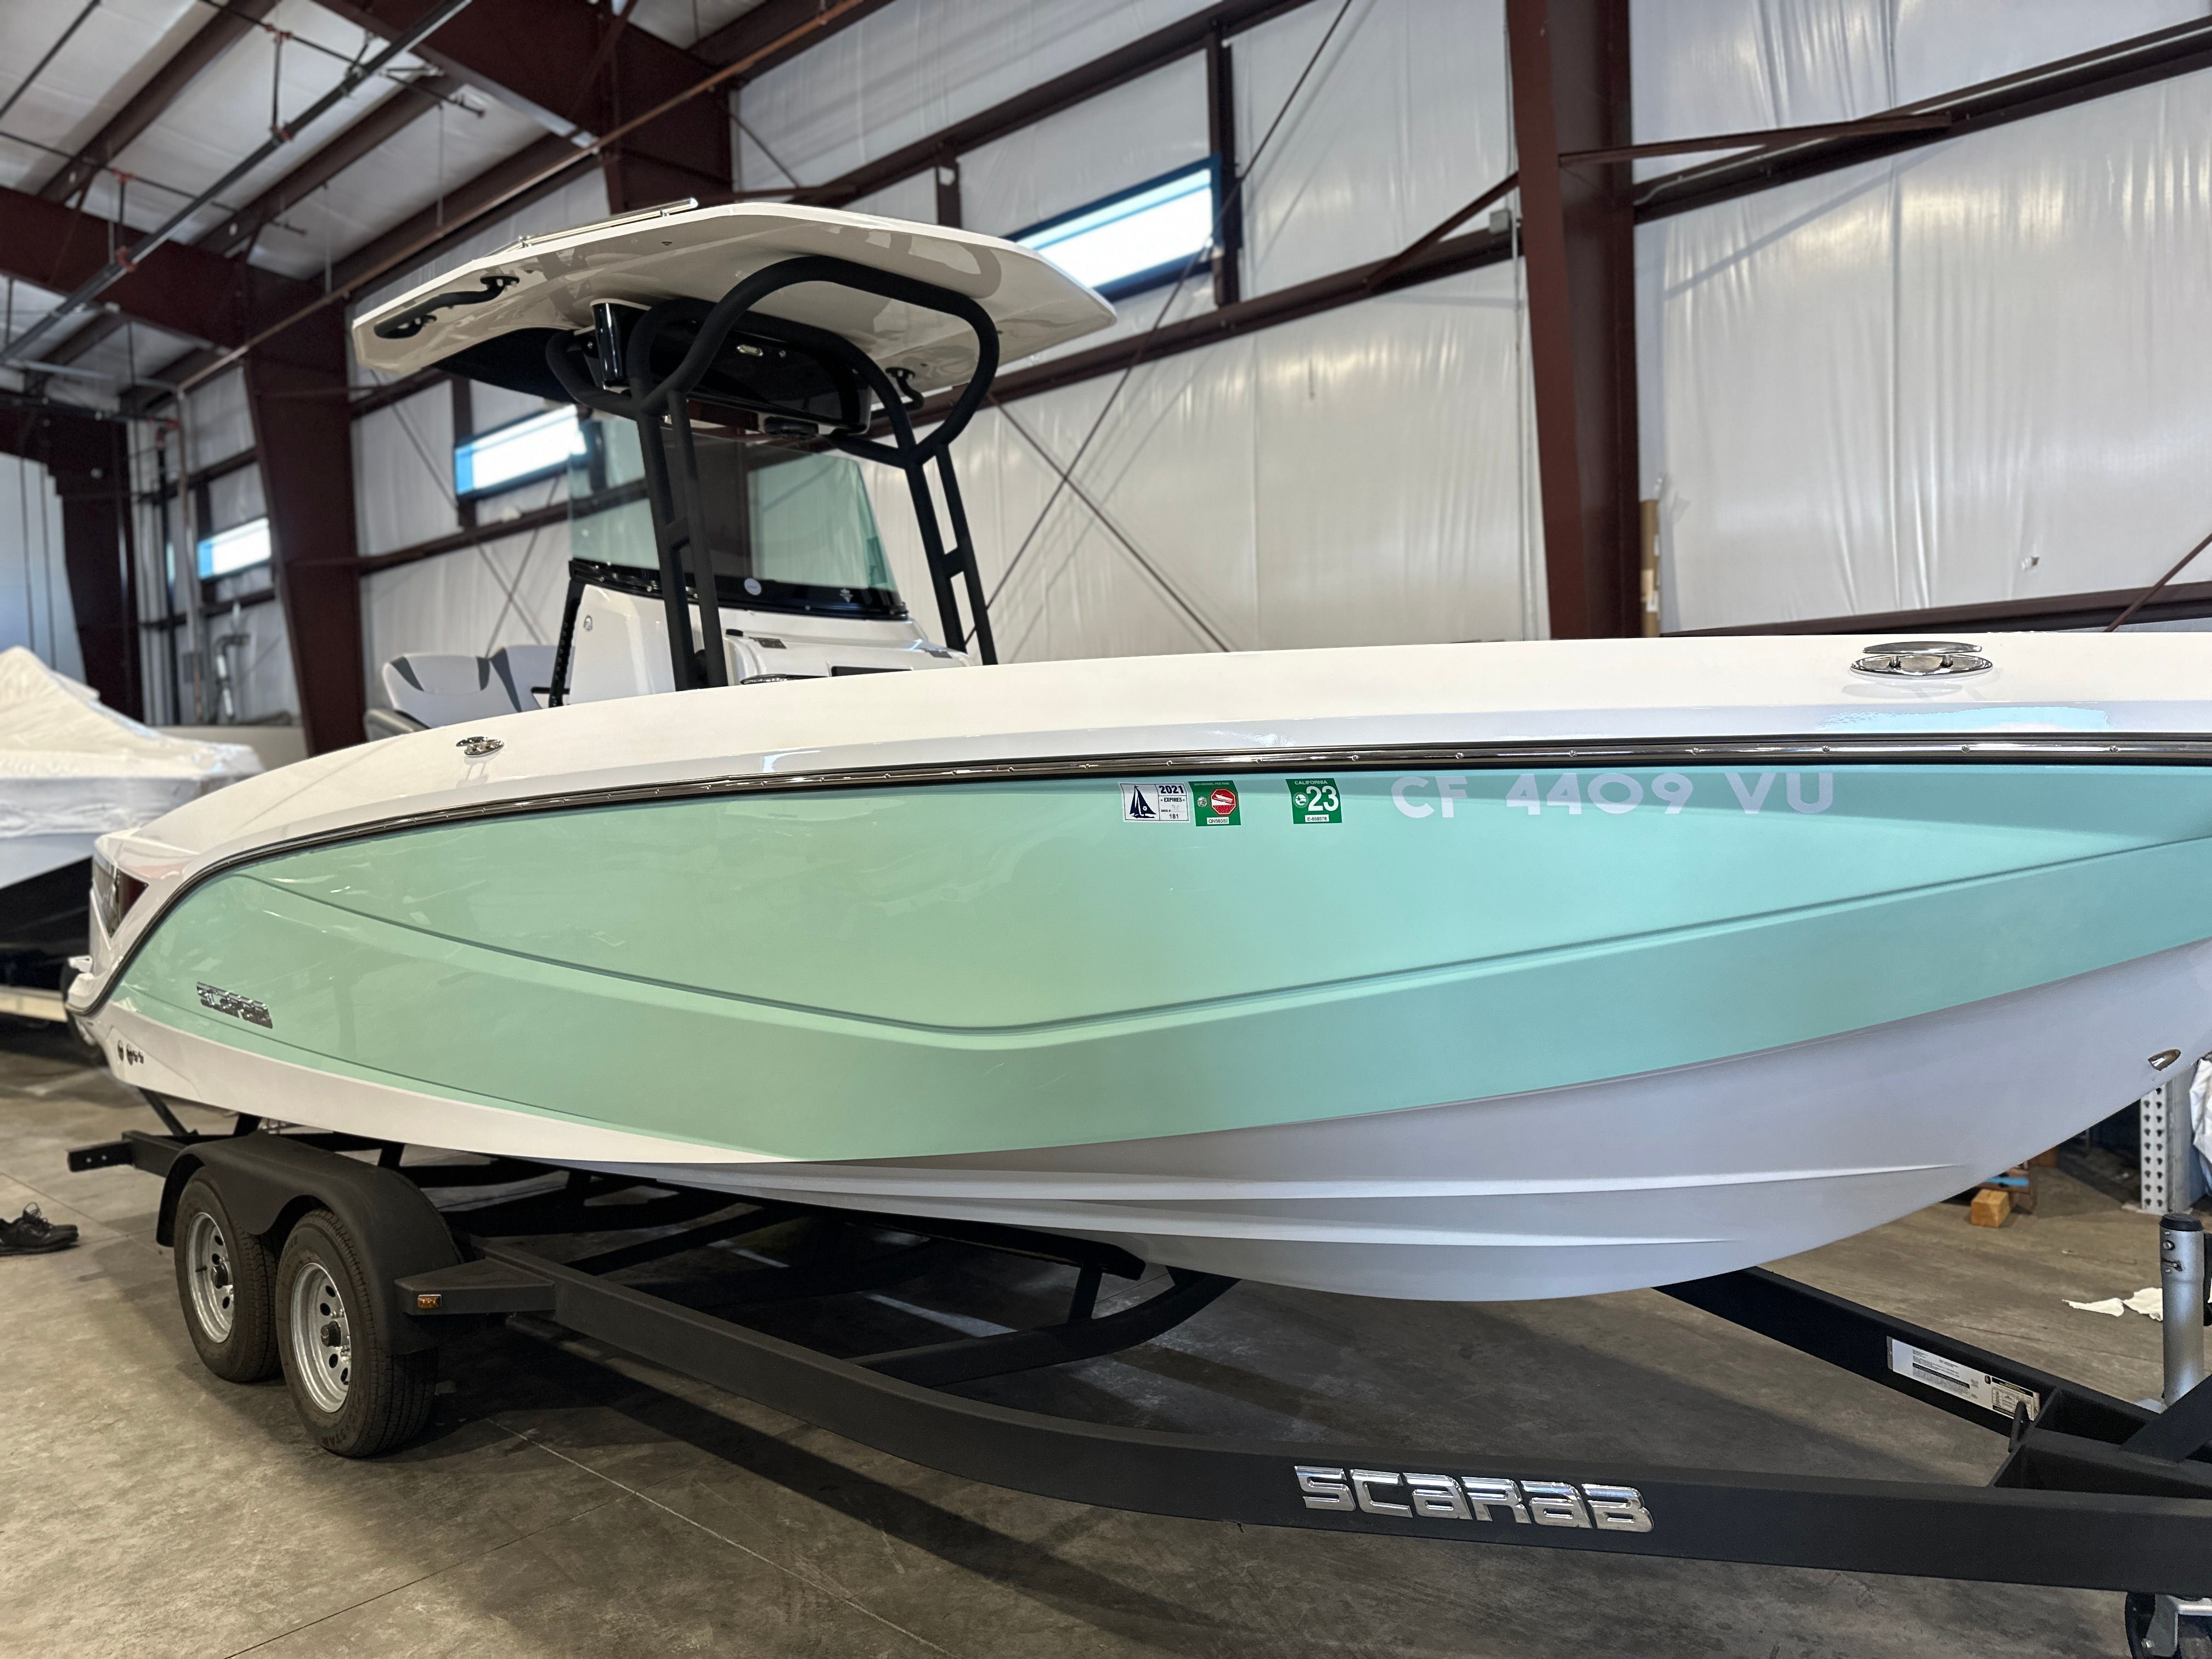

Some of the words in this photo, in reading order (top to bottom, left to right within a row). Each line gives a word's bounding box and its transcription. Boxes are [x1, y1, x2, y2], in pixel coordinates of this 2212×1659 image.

[1159, 785, 1184, 794] 2021
[1306, 785, 1339, 811] 23
[1391, 775, 1467, 818] CF
[1505, 773, 1694, 815] 4409
[1725, 772, 1833, 814] VU
